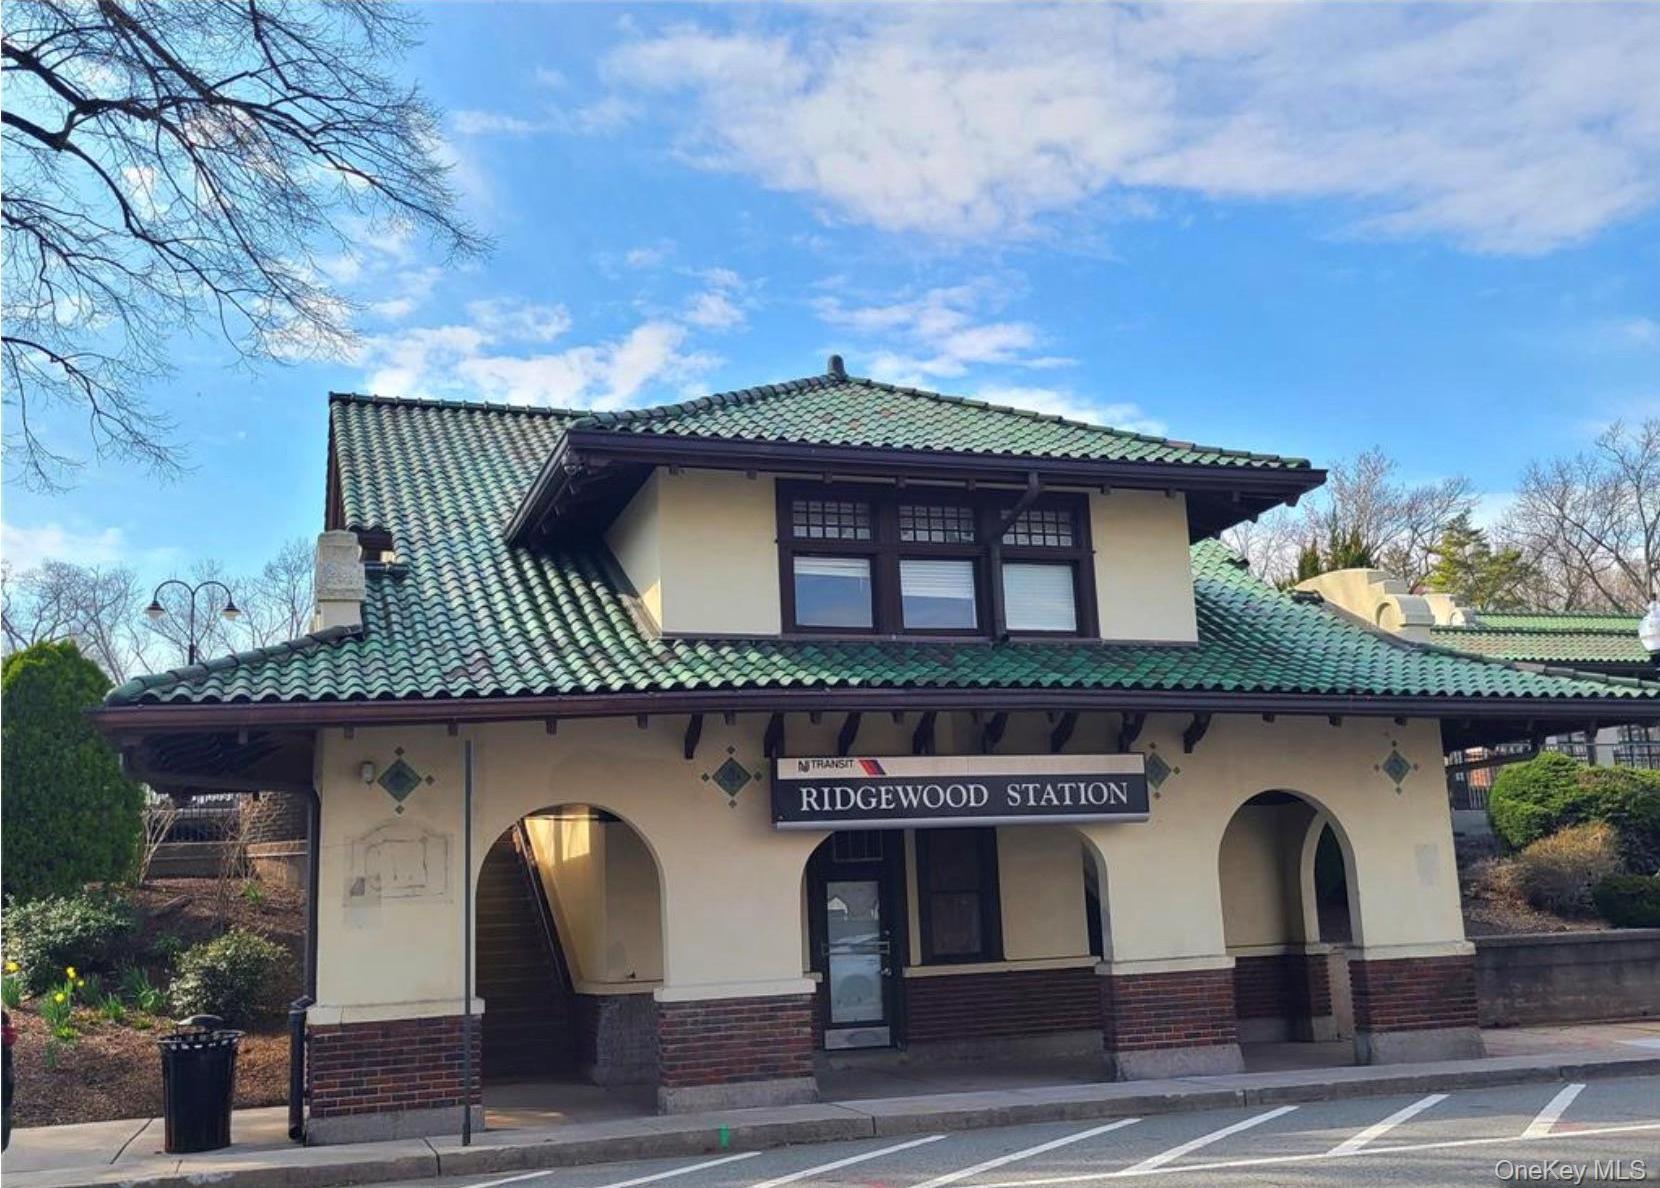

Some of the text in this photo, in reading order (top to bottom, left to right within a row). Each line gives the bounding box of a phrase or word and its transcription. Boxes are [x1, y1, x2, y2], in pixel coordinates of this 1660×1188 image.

[811, 759, 854, 769] TRANSIT
[799, 782, 1128, 811] RIDGEWOOD STATION
